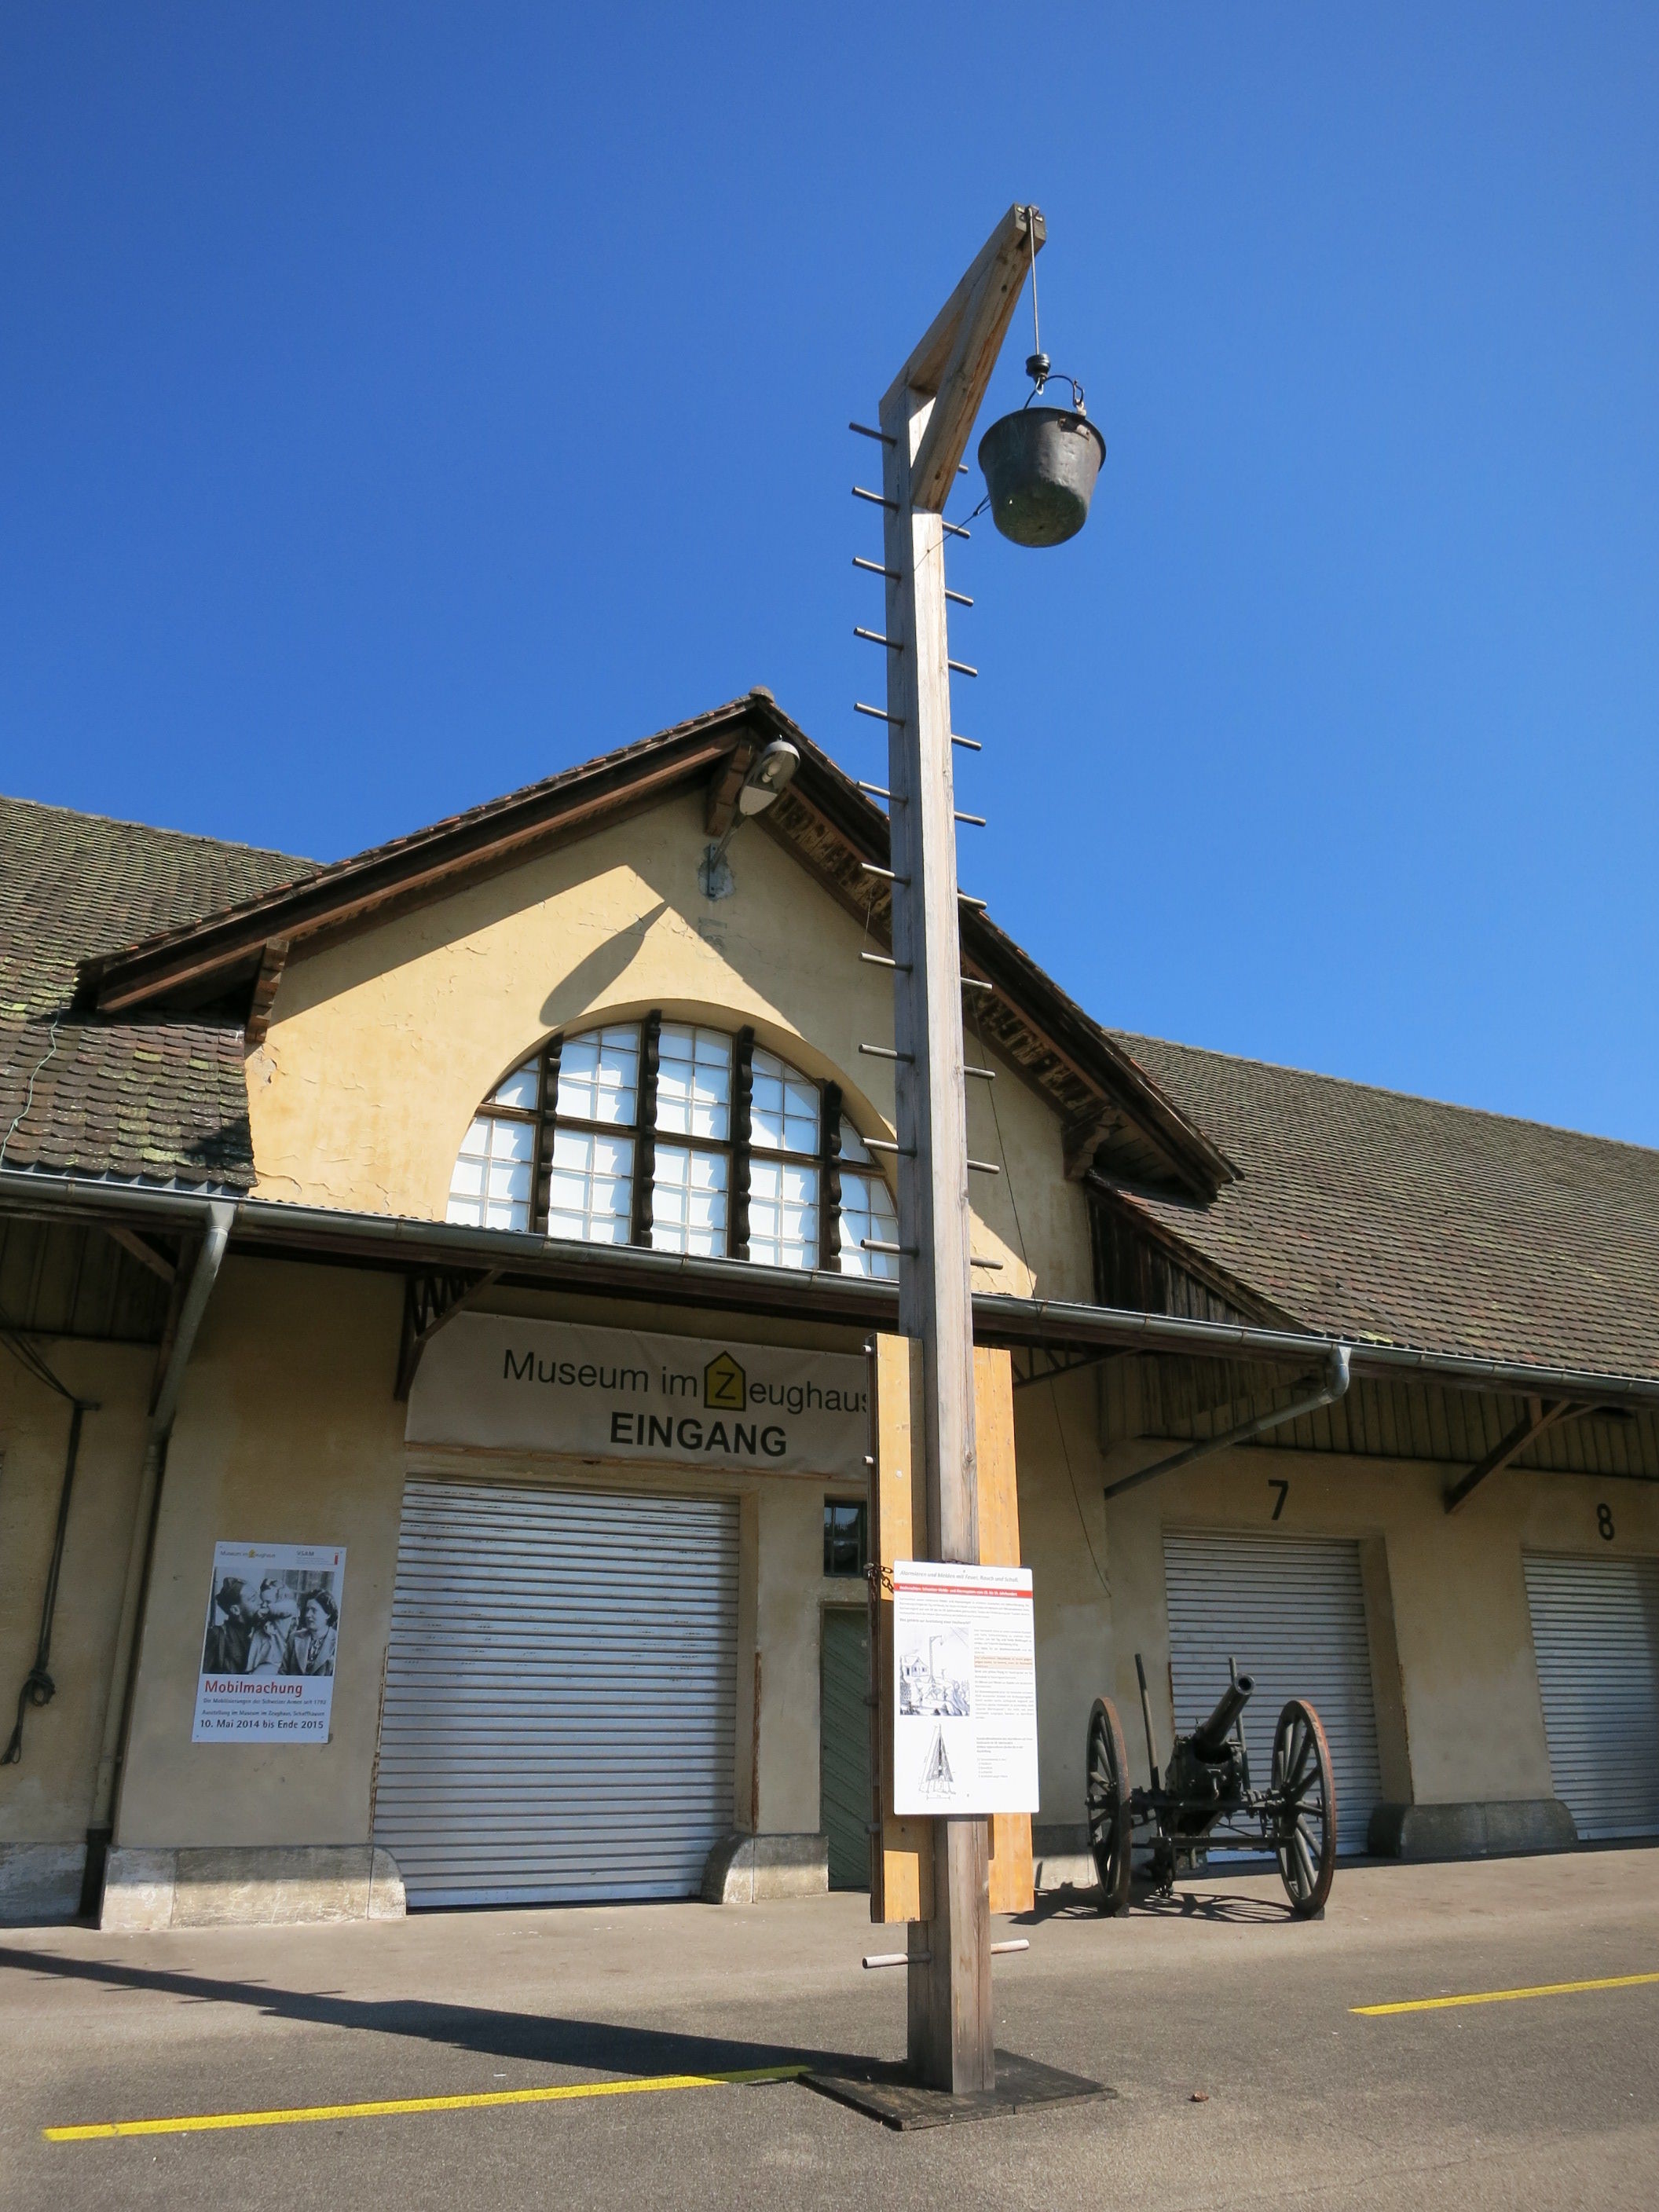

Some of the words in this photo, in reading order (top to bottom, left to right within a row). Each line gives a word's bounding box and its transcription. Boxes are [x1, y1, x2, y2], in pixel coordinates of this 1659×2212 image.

[503, 1349, 648, 1393] Museum
[662, 1366, 697, 1397] im
[610, 1412, 787, 1457] EINGANG
[1268, 1479, 1289, 1521] 7
[1596, 1503, 1615, 1541] 8
[204, 1679, 303, 1697] Mobilmachung
[200, 1719, 214, 1728] 10.
[217, 1719, 234, 1728] Mai
[236, 1719, 259, 1728] 2014
[262, 1719, 274, 1728] bis
[277, 1719, 298, 1729] Ende
[301, 1720, 324, 1729] 2015
